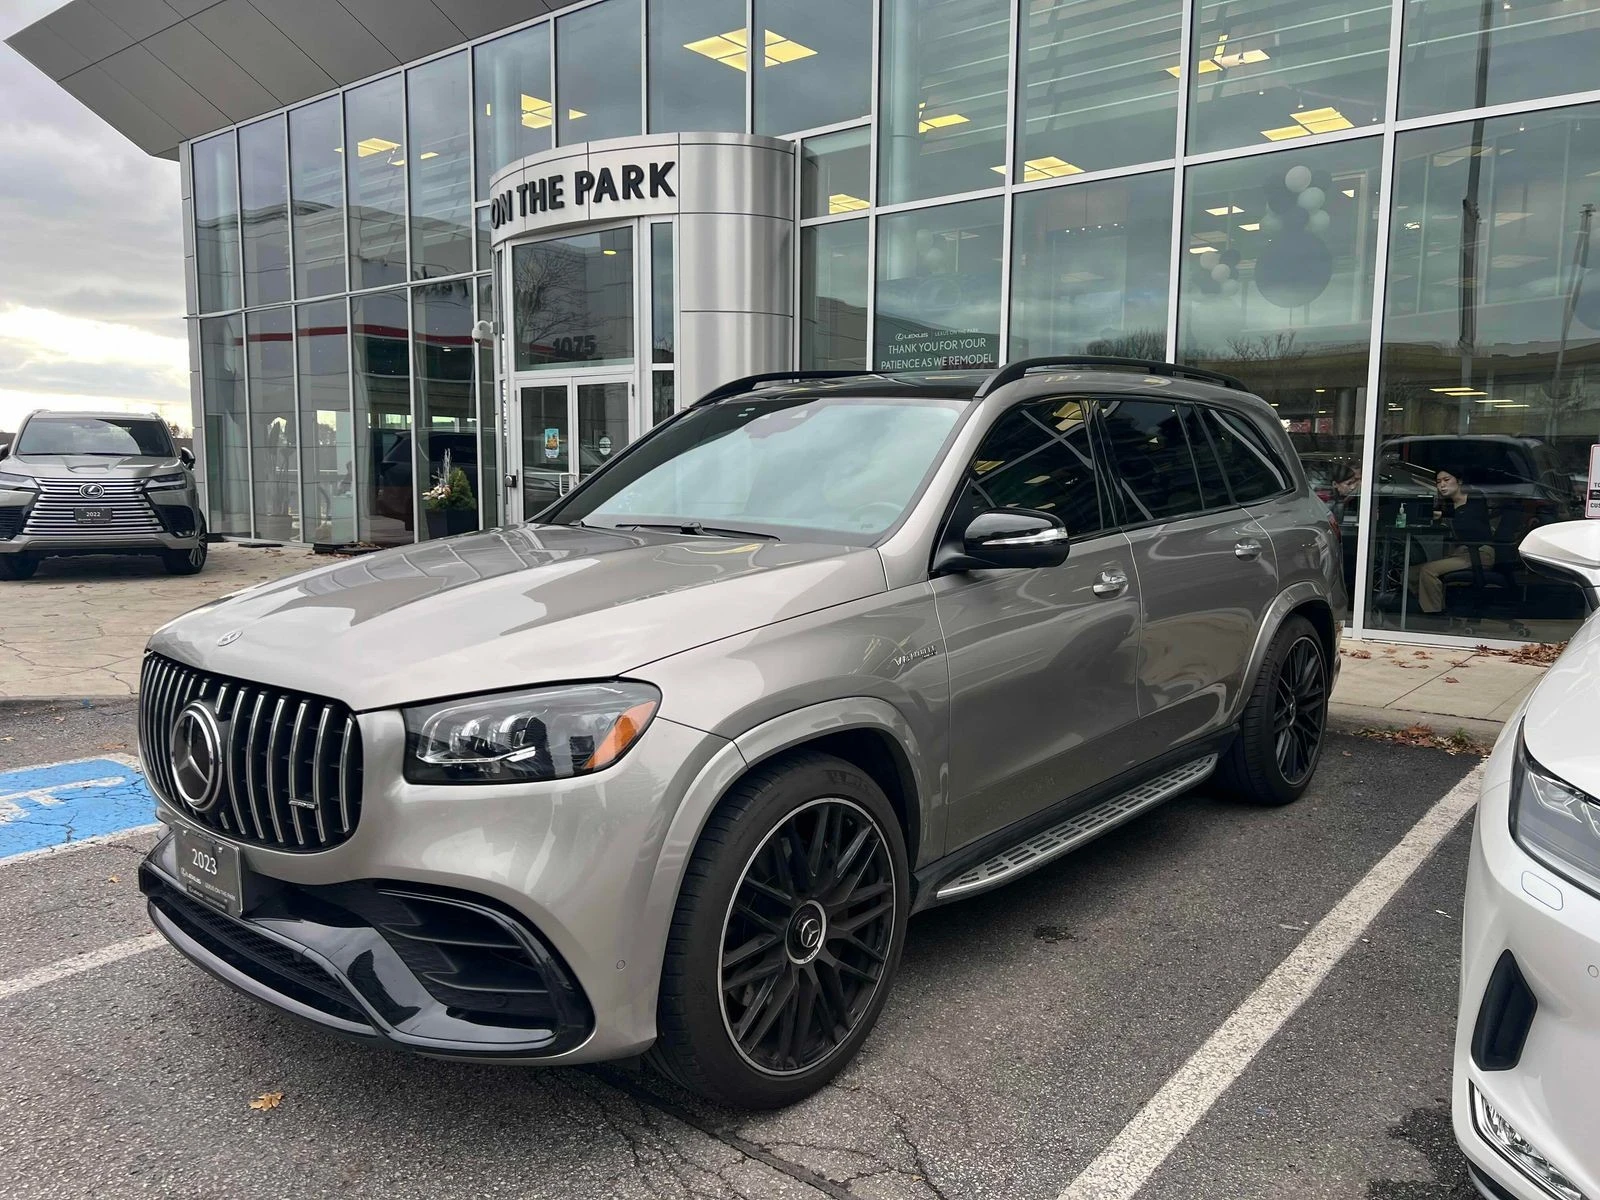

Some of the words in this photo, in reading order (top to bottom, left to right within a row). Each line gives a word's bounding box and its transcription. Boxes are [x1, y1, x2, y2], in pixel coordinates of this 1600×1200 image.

[490, 190, 513, 230] ON
[516, 174, 565, 218] THE
[574, 161, 676, 206] PARK
[552, 334, 598, 357] 1075
[888, 343, 917, 354] THANK
[918, 341, 939, 352] YOU
[939, 340, 958, 351] FOR
[959, 337, 986, 349] YOUR
[881, 358, 920, 370] PATIENCE
[921, 357, 932, 367] AS
[933, 356, 948, 367] WE
[948, 353, 994, 366] REMODEL
[192, 848, 217, 875] 2023
